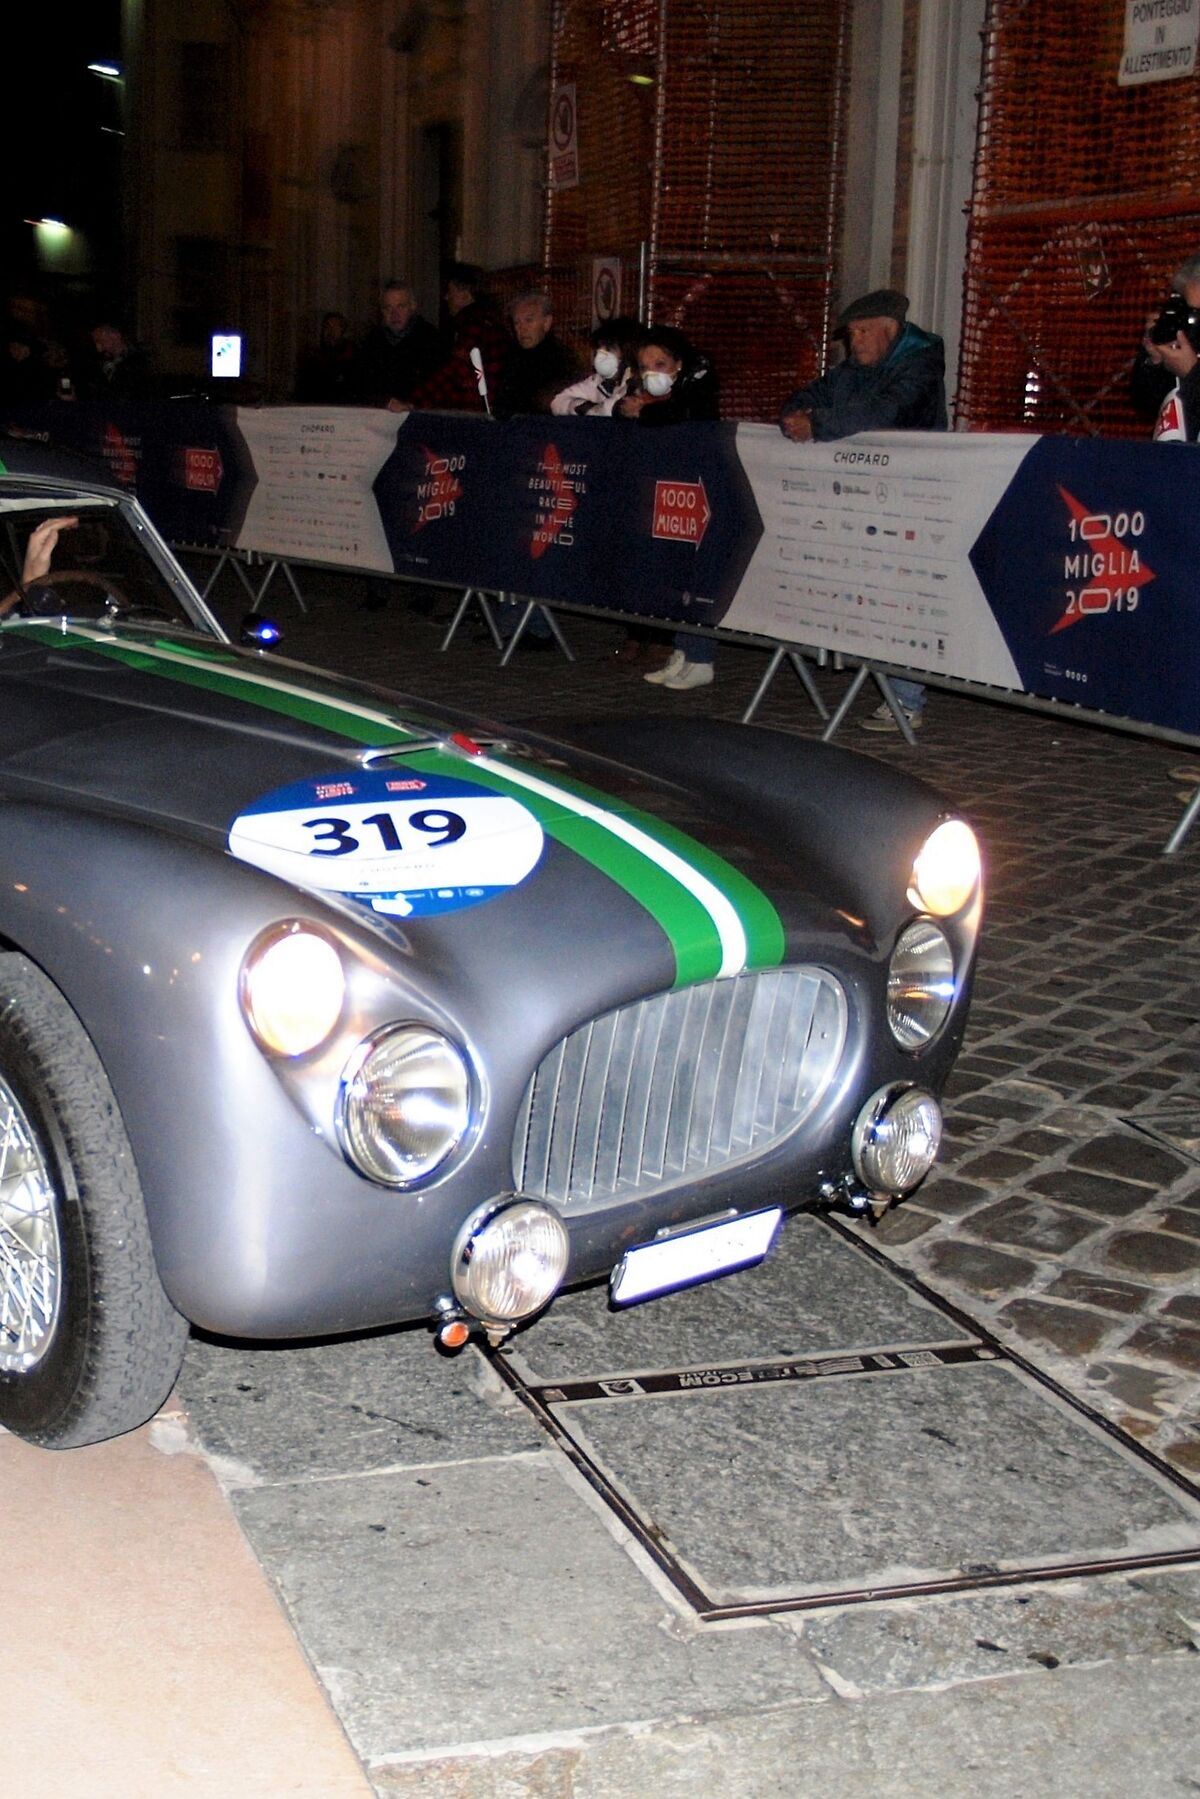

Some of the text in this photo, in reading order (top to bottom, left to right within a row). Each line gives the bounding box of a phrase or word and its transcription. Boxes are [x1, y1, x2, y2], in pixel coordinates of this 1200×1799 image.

[1132, 0, 1192, 23] PONTEGGIO
[1155, 25, 1165, 44] IN
[1123, 46, 1192, 75] ALLESTIMENTO
[301, 424, 336, 433] CHOPARD
[190, 455, 214, 469] 1000
[425, 455, 466, 475] 1000
[833, 451, 890, 467] CHOPARD
[563, 464, 587, 476] MOST
[417, 479, 459, 500] MIGLIA
[528, 478, 587, 494] BEAUTIFUL
[538, 497, 573, 510] RACE
[662, 489, 697, 509] 1000
[418, 501, 456, 522] 2019
[536, 514, 546, 524] IN
[656, 514, 698, 536] MIGLIA
[1068, 511, 1145, 543] 1000
[532, 531, 574, 545] WORLD
[1064, 549, 1140, 580] MIGLIA
[1065, 586, 1139, 615] 2019
[301, 808, 467, 857] 319
